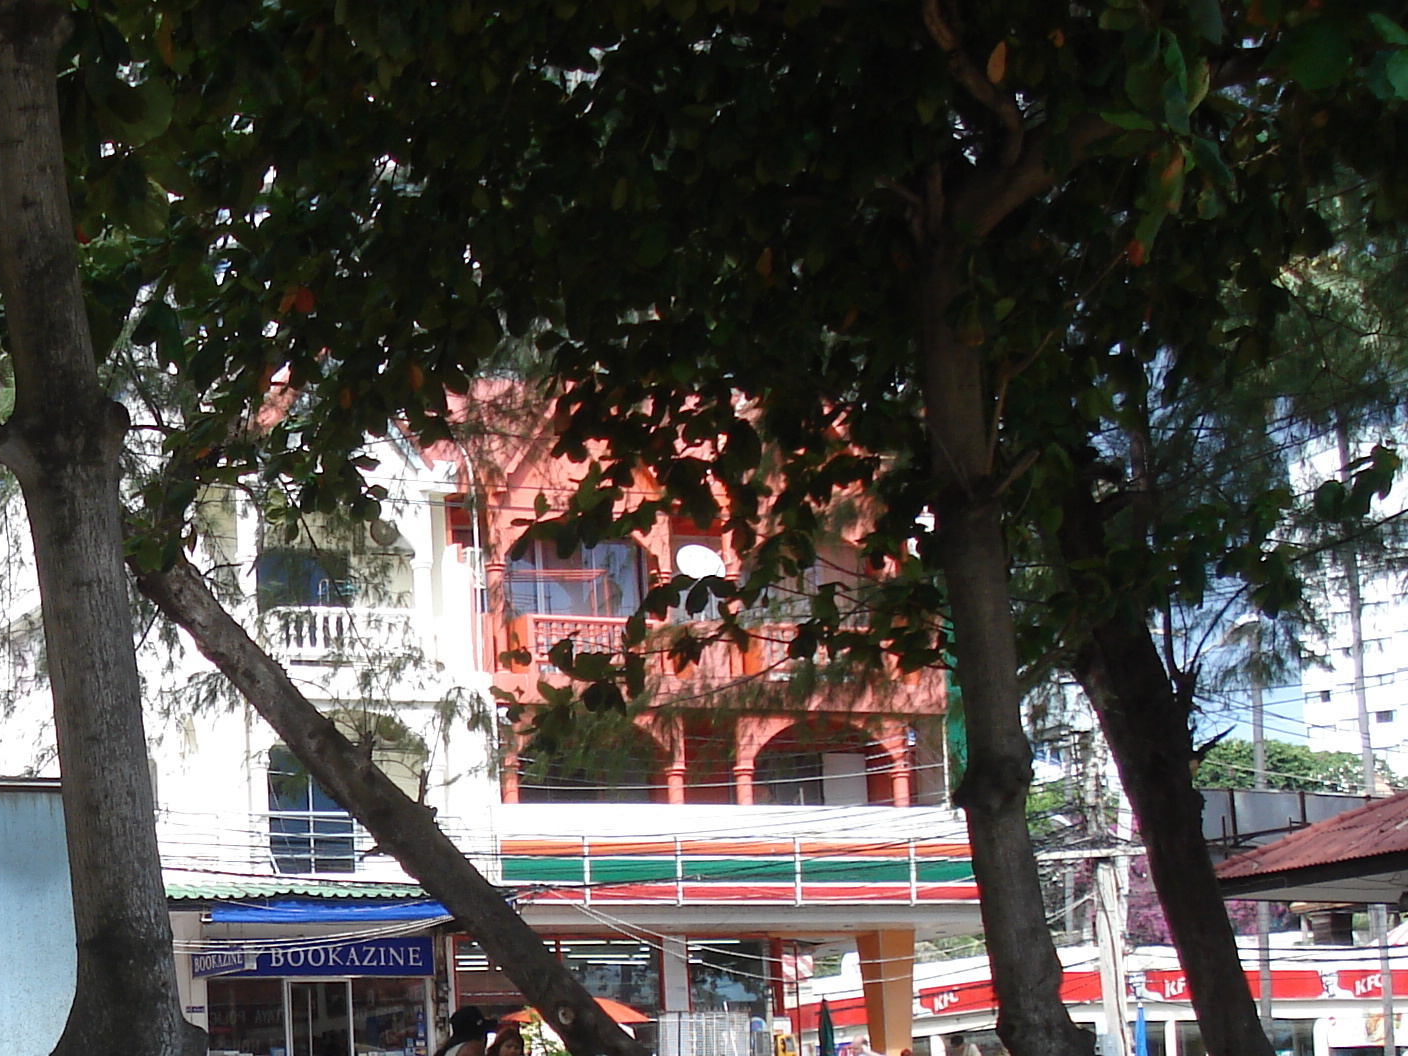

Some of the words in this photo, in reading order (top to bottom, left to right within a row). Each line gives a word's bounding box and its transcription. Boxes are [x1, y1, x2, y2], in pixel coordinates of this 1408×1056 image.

[194, 950, 243, 973] BOOKAZINE
[270, 945, 423, 968] BOOKAZINE
[1163, 976, 1186, 999] KF
[1354, 973, 1383, 996] KFC
[933, 986, 960, 1011] KFC
